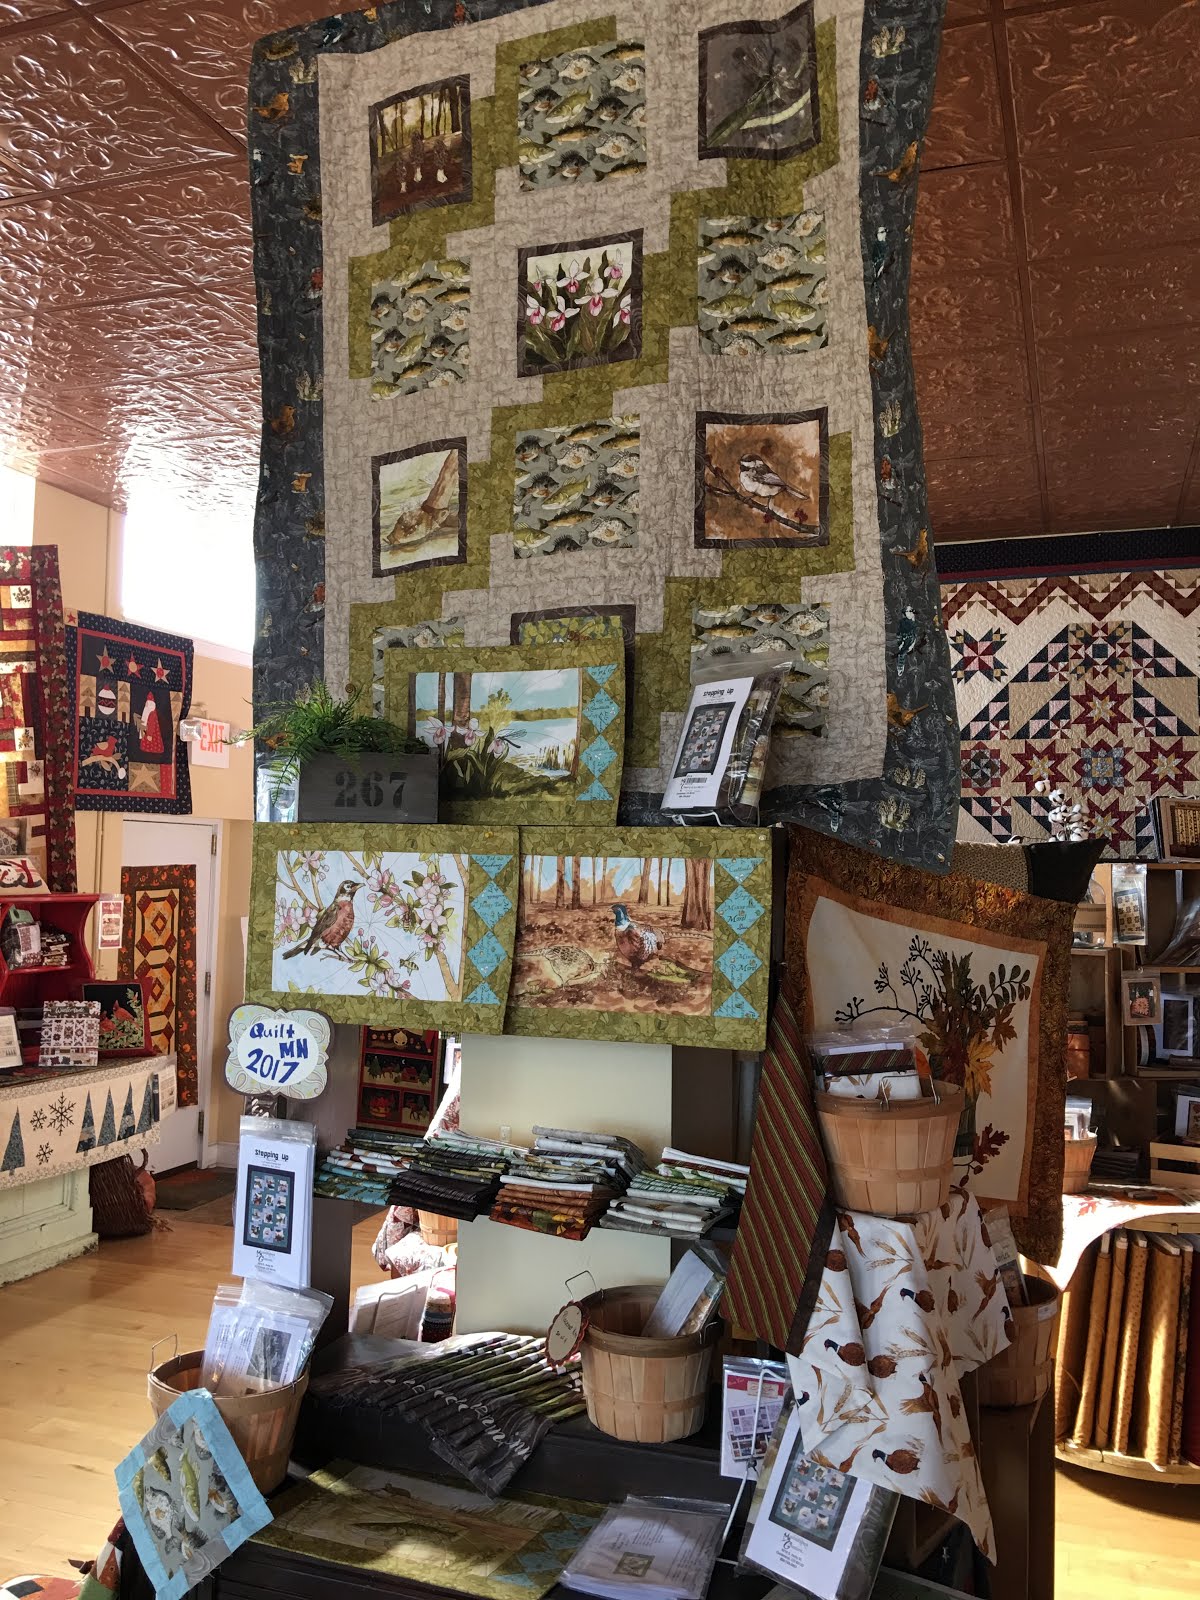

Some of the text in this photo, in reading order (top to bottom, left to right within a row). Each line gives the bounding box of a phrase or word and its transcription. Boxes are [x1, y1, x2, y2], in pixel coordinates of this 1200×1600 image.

[200, 722, 224, 753] EXIT
[335, 771, 408, 809] 267
[249, 1022, 295, 1039] Quilt
[279, 1038, 309, 1059] MN
[246, 1048, 300, 1084] 2017
[255, 1149, 279, 1161] Stepping
